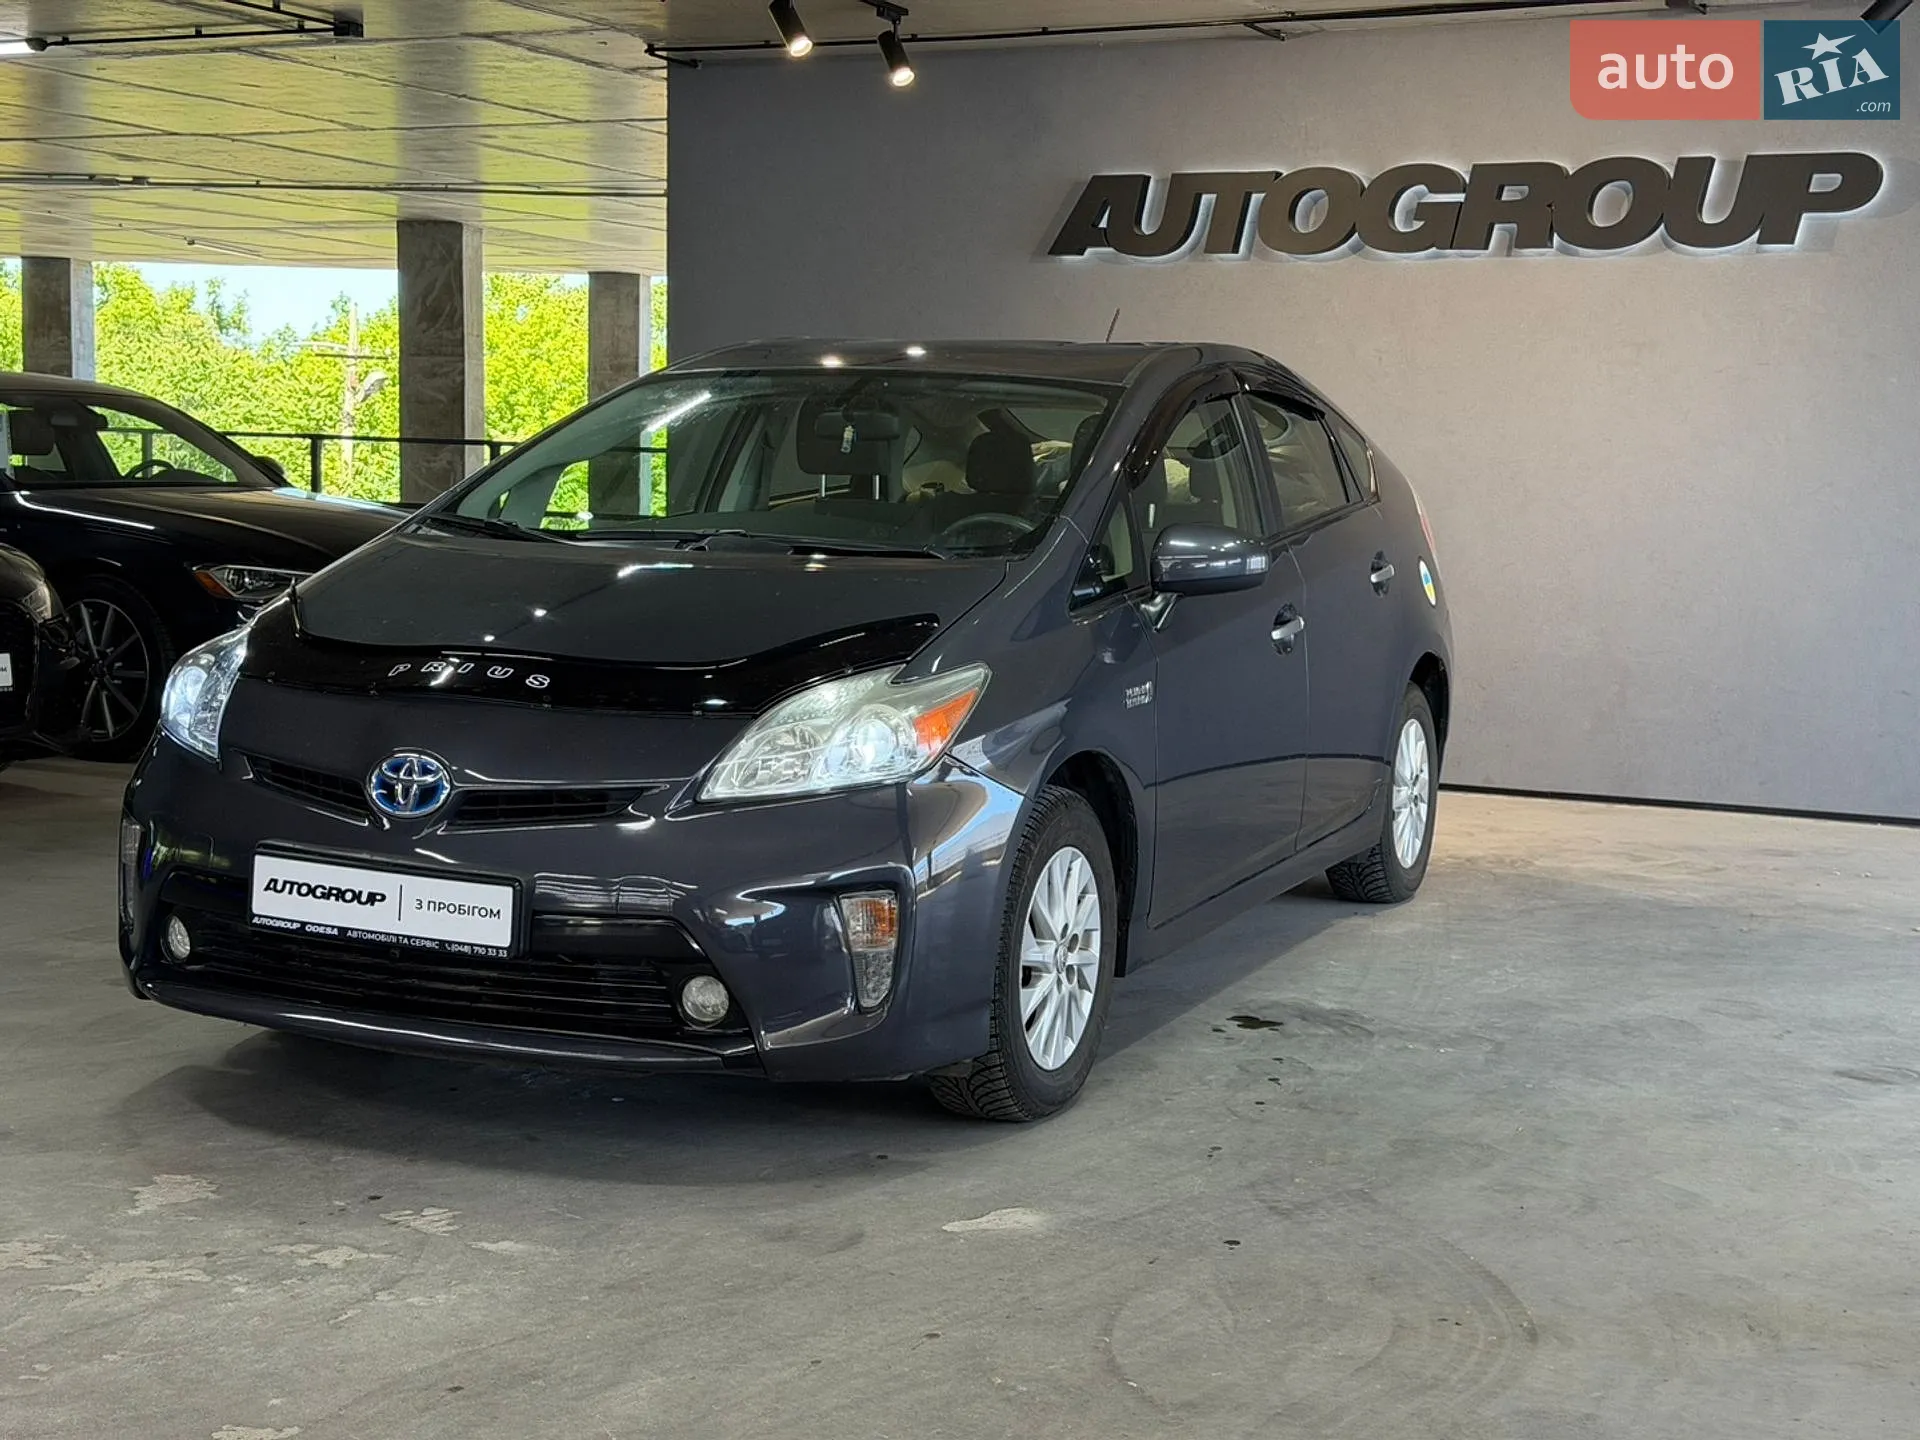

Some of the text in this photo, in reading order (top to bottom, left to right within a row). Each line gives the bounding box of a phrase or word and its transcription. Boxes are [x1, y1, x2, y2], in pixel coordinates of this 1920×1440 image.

[1047, 151, 1885, 257] AUTOGROUP
[388, 662, 551, 689] PRIUS
[263, 877, 387, 907] AUTOGROUP
[427, 900, 501, 920] ПРОБІГОМ
[252, 916, 339, 936] AUTOGROUP ODESA
[410, 938, 440, 949] СЕРВІС
